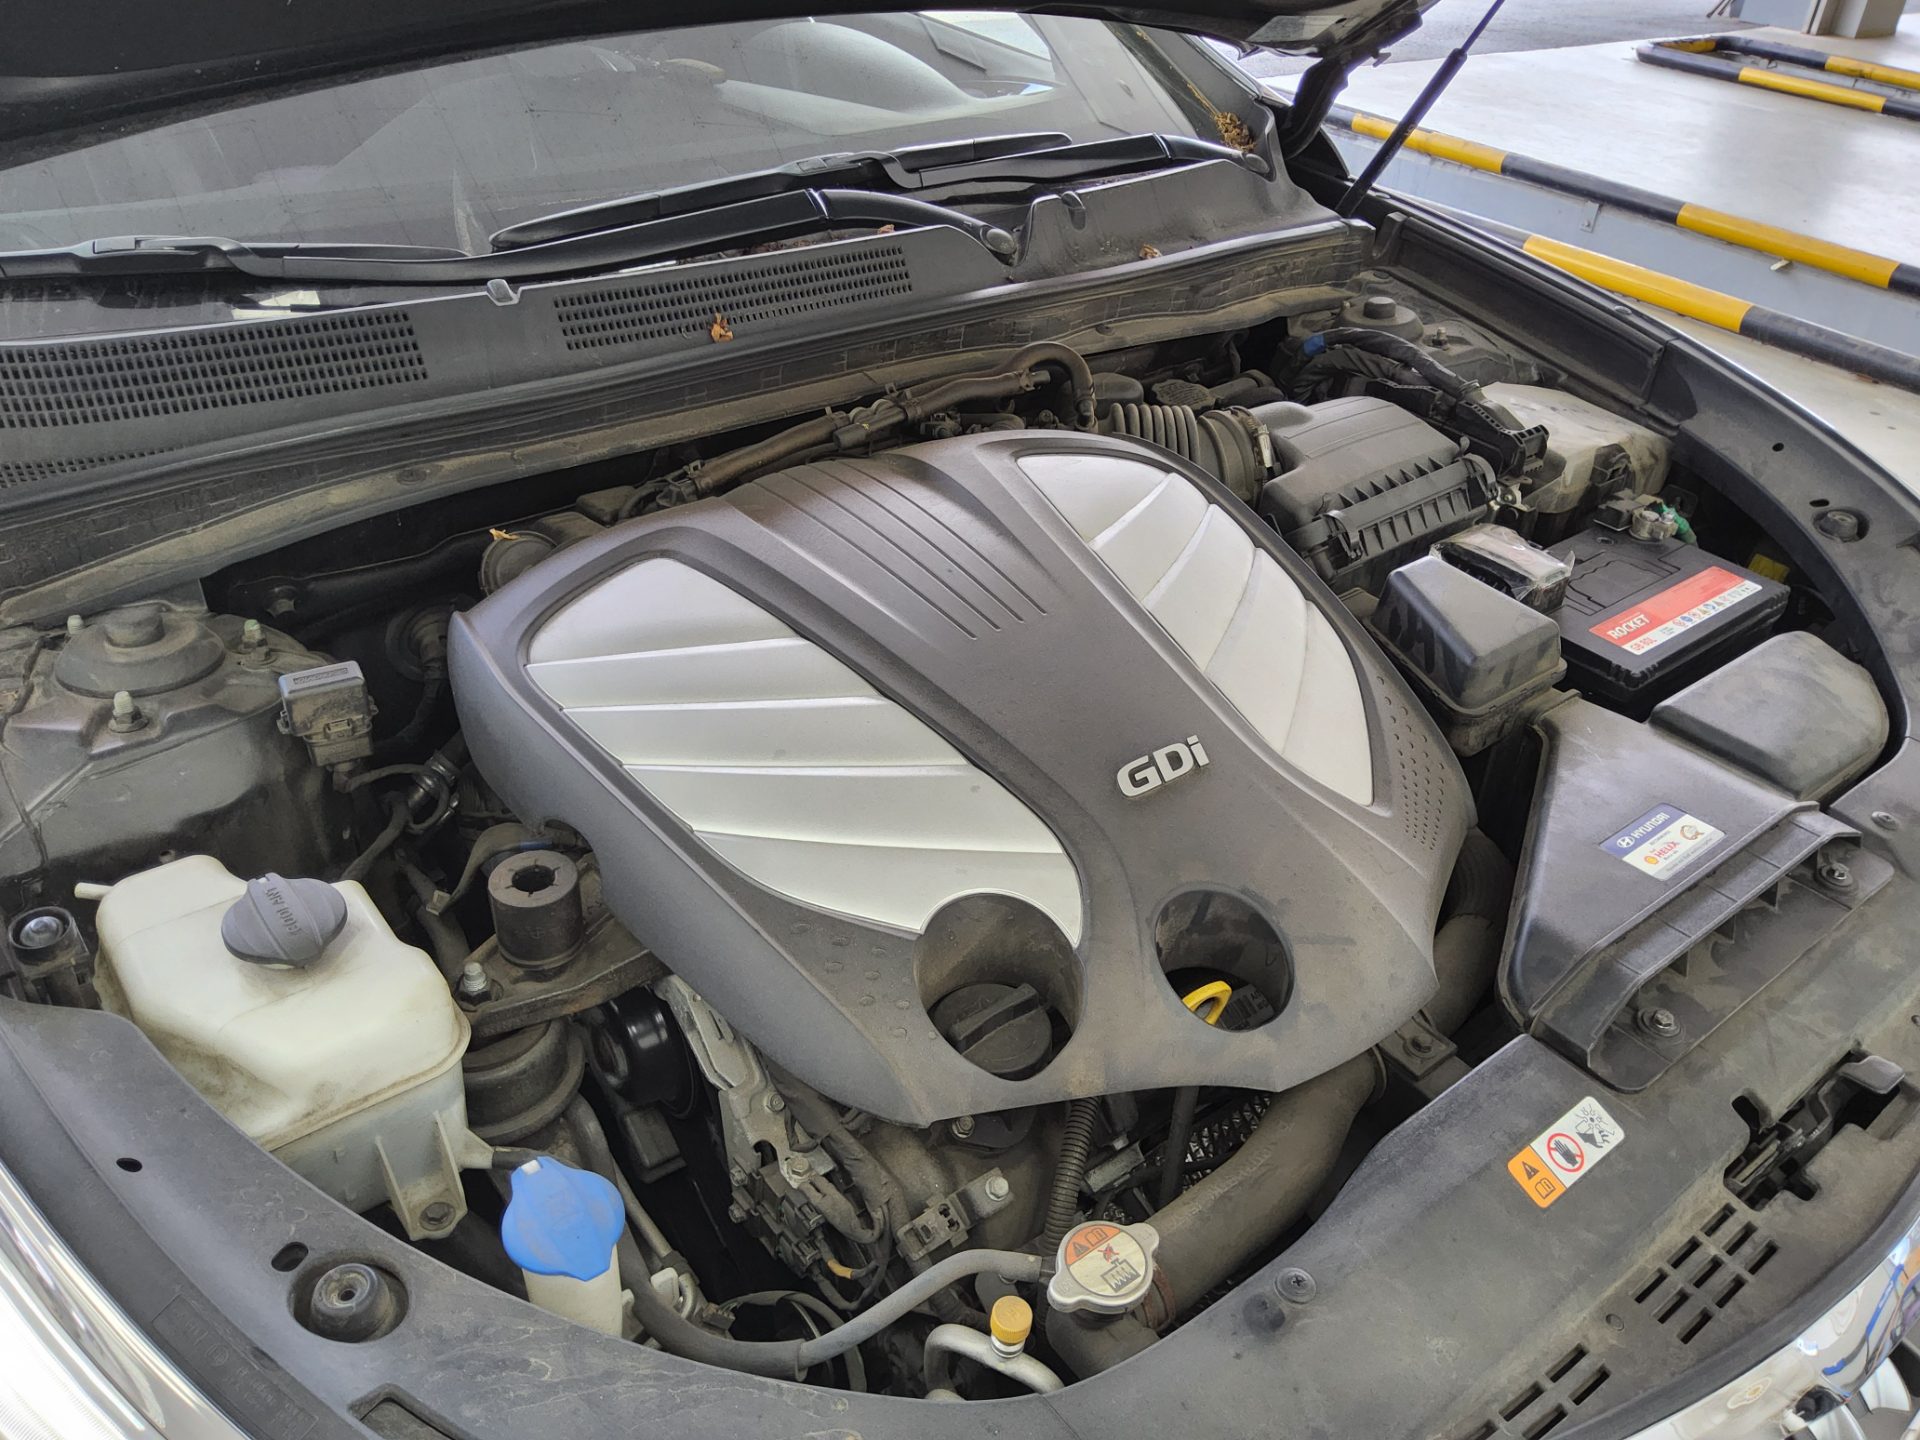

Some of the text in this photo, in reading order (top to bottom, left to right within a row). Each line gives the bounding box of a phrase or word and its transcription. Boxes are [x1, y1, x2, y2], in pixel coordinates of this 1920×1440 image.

[1607, 614, 1650, 639] ROCKET
[1117, 735, 1210, 797] GDi
[1630, 812, 1671, 839] HYUNDAI
[1654, 840, 1681, 858] HELIX
